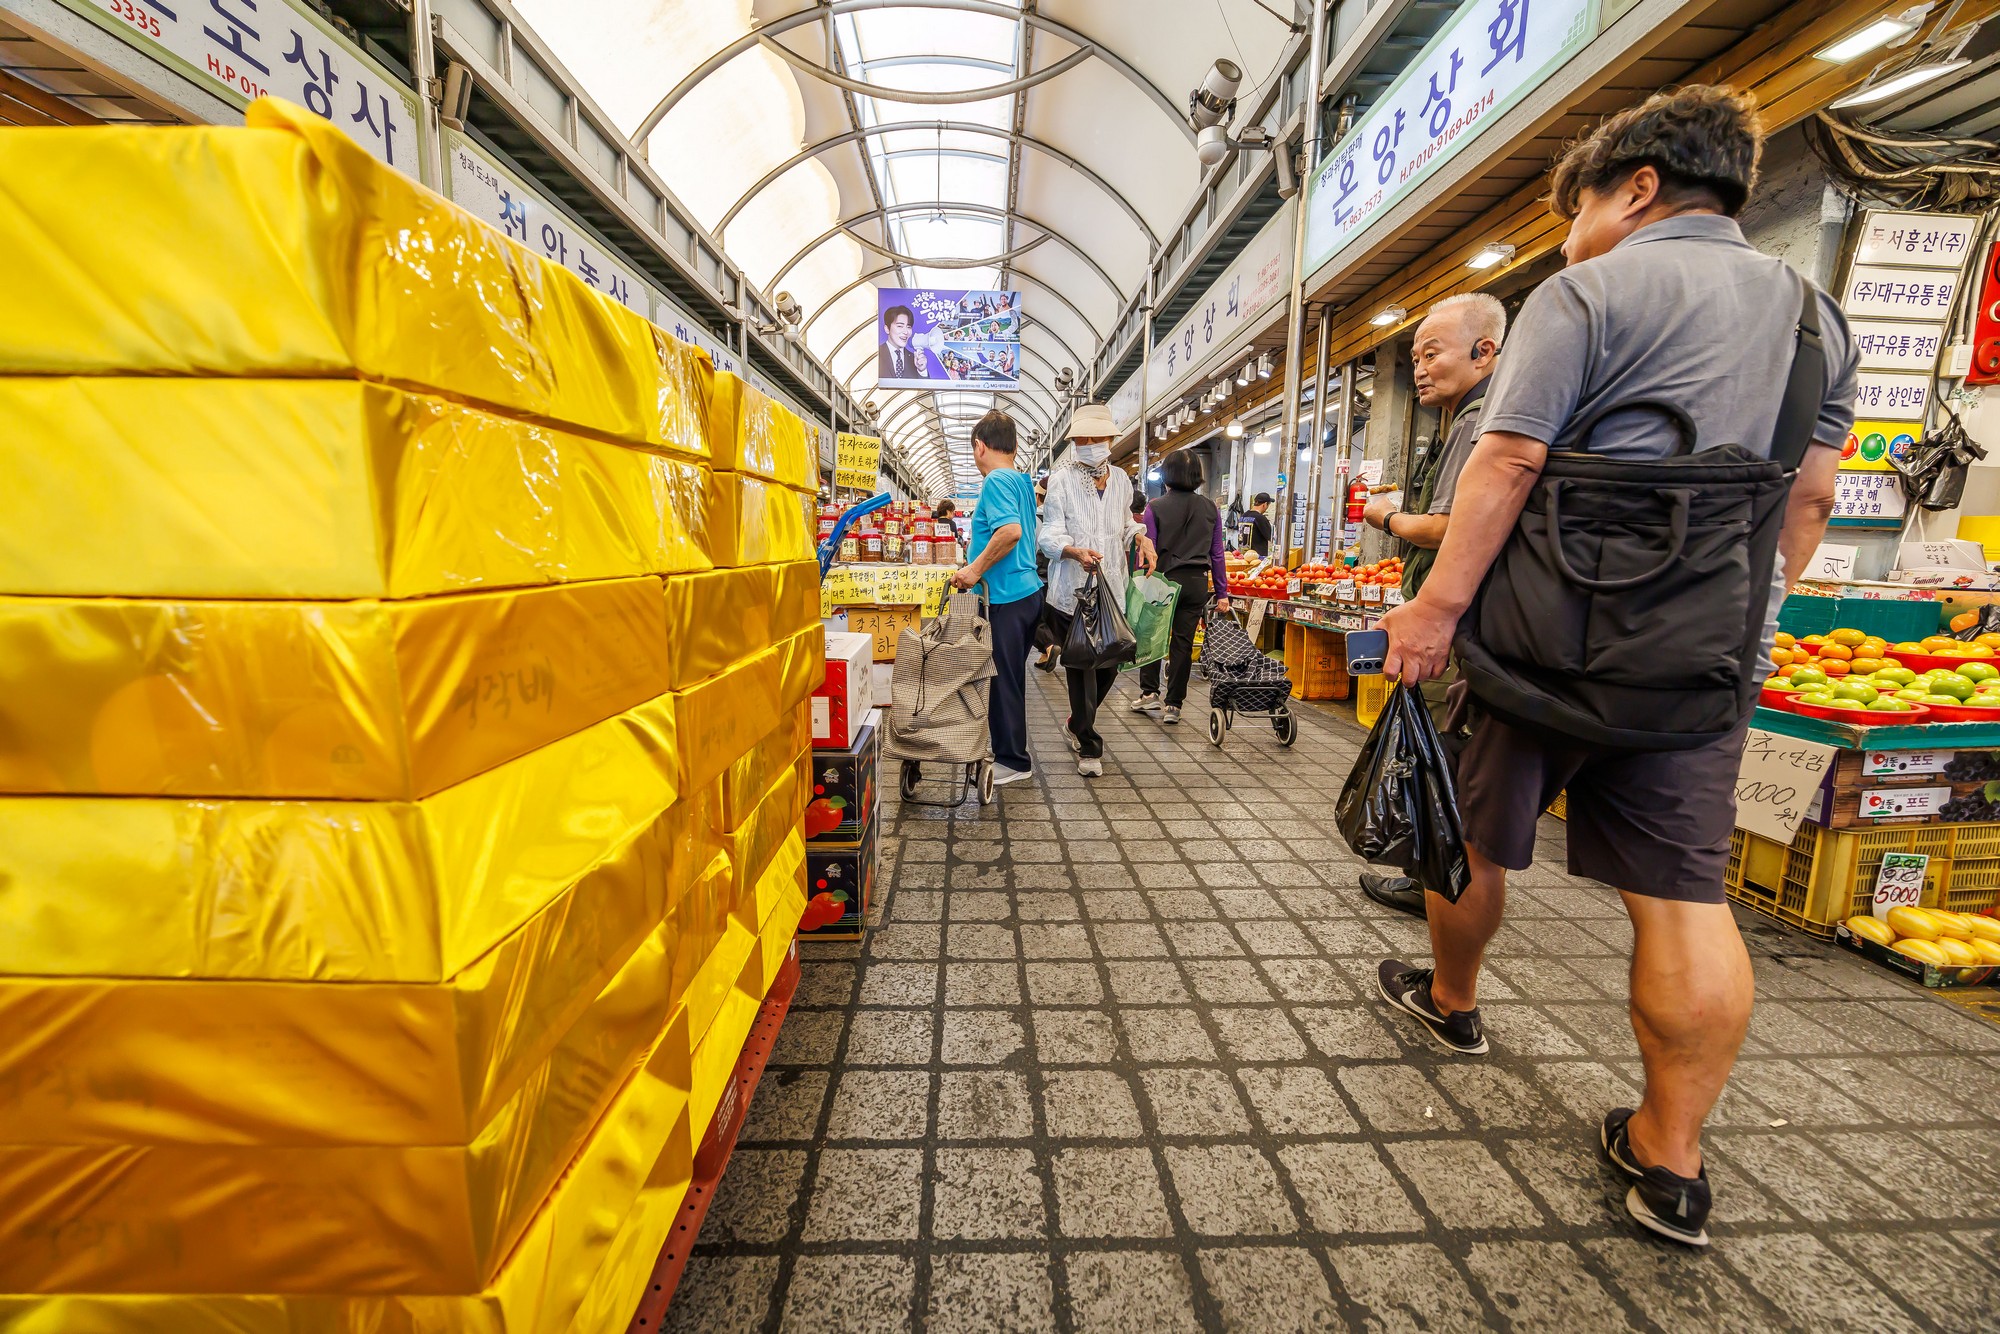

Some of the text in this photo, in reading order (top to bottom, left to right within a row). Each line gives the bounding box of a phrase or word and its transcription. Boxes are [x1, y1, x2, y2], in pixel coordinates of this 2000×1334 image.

[206, 53, 236, 83] H.P
[143, 0, 397, 166] 도상사
[1332, 0, 1530, 226] 온양상회
[1400, 88, 1495, 184] H.P 010-9169-0314
[459, 152, 475, 176] 청과
[1349, 189, 1382, 228] 963-7573
[1167, 274, 1241, 377] 중앙상회
[1856, 385, 1926, 408] 시장 상인회
[1841, 489, 1878, 502] 푸릇해
[1833, 502, 1882, 515] 동광상회
[882, 569, 918, 580] 오징어젓
[1912, 576, 1945, 585] Tomango
[1909, 754, 1934, 766] 포도
[1906, 797, 1929, 808] 포도
[1774, 807, 1798, 833] 원
[1874, 884, 1919, 904] 5000
